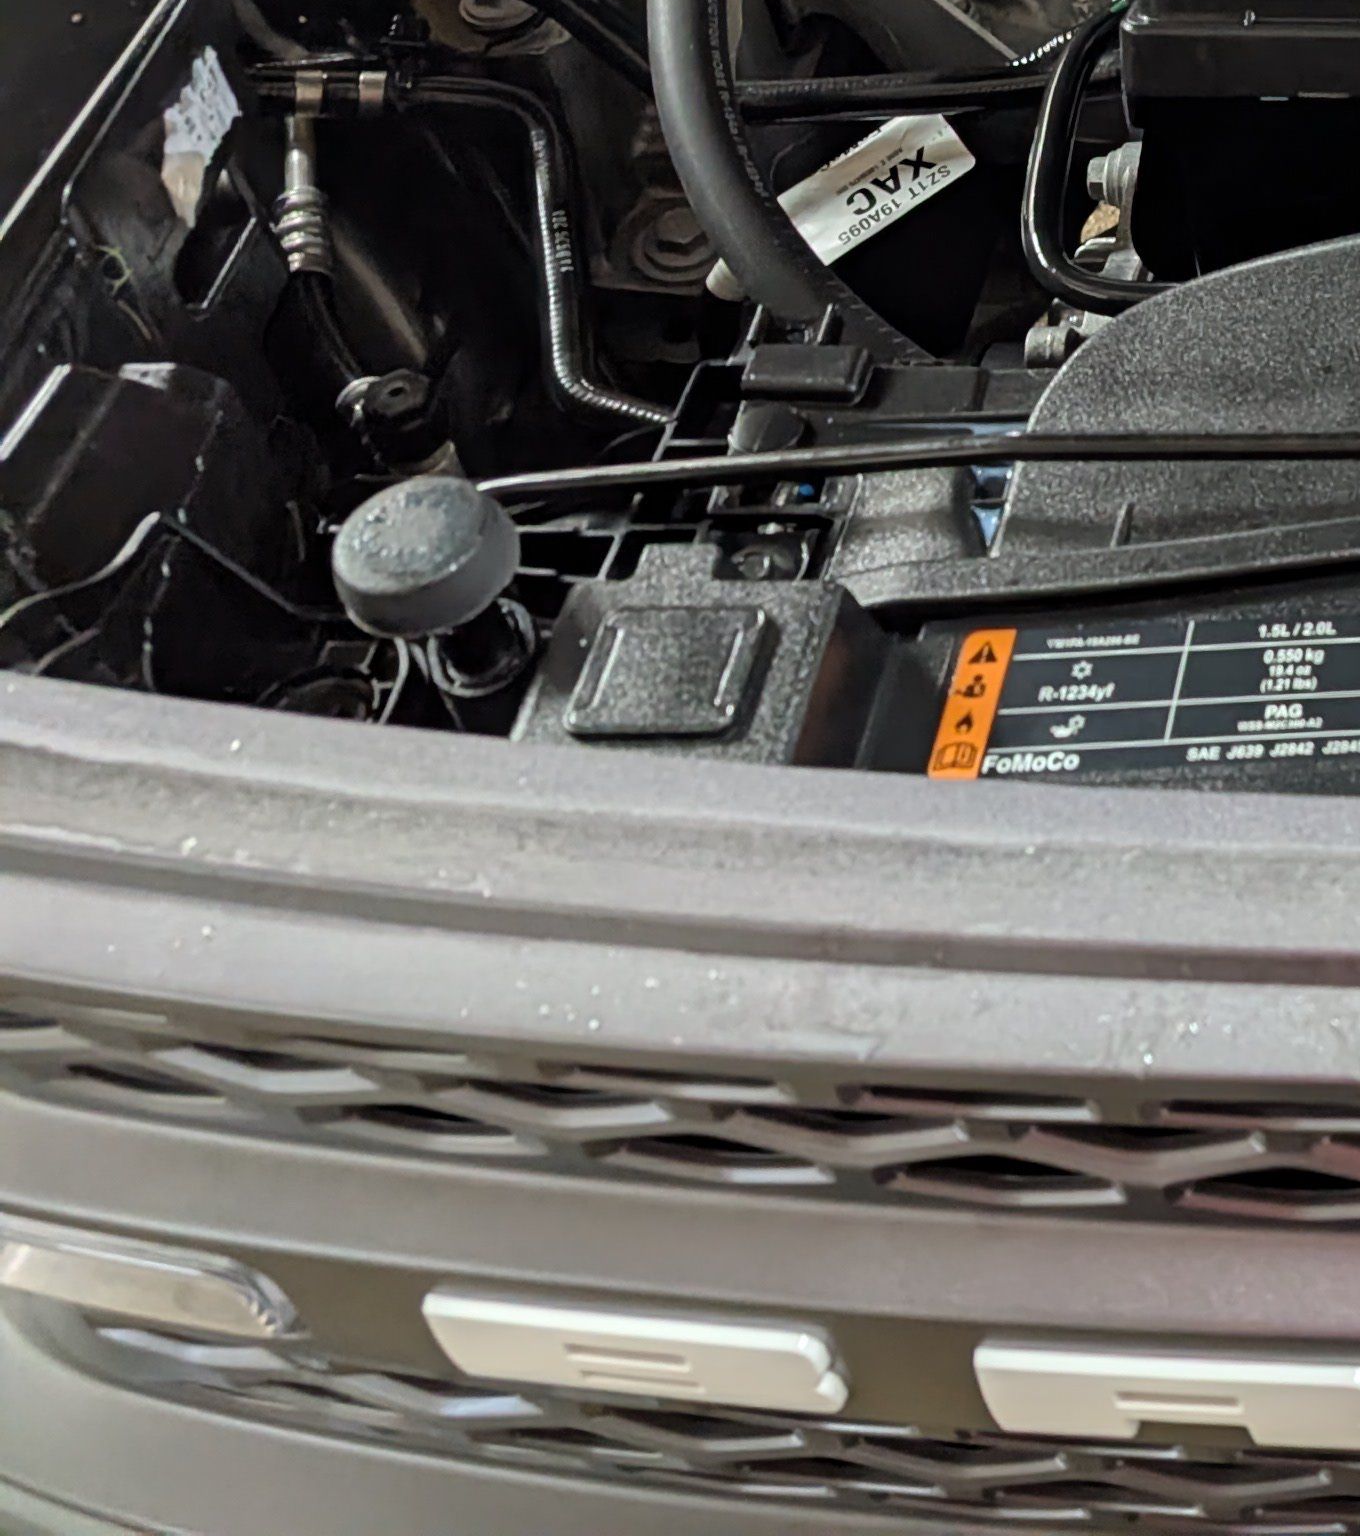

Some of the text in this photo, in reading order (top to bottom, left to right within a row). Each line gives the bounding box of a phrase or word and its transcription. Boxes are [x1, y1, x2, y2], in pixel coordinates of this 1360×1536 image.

[846, 146, 937, 216] XAC
[908, 164, 952, 201] SZ1T
[837, 197, 903, 246] 19A095
[1258, 623, 1291, 639] 1.5L
[1301, 620, 1338, 637] 2.0L
[1263, 647, 1326, 665] 0.550 kg
[1037, 681, 1117, 703] R-1234yf
[1264, 703, 1304, 720] PAG
[980, 750, 1081, 775] FoMoCo
[1185, 745, 1222, 762] SAE
[1225, 743, 1265, 761] J639
